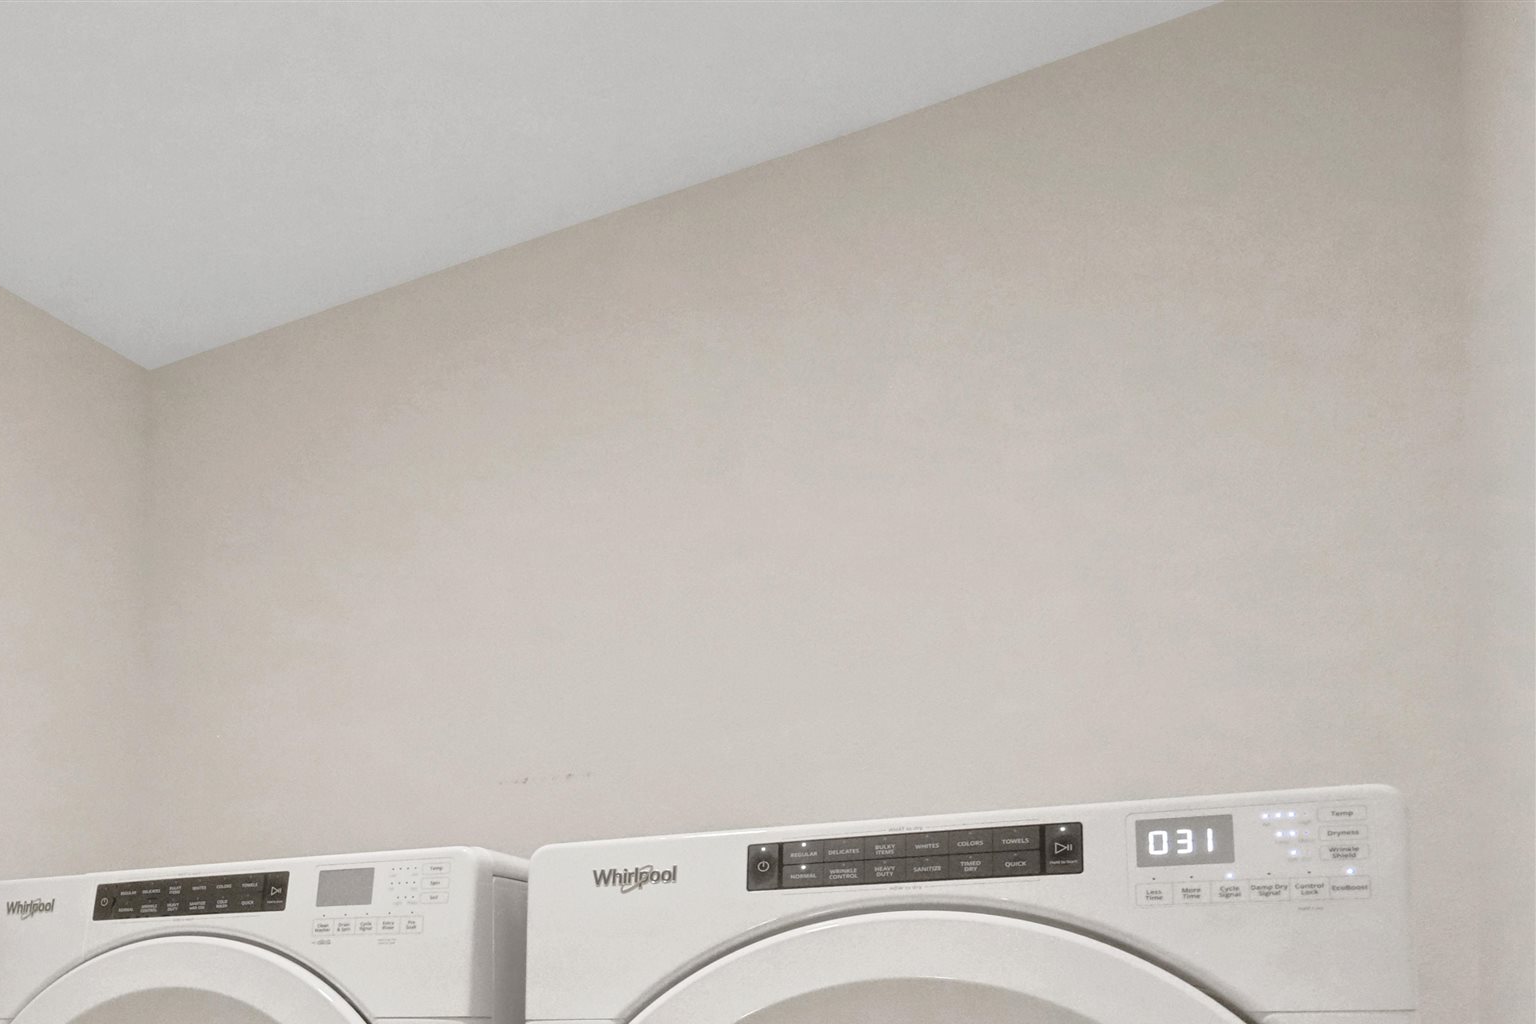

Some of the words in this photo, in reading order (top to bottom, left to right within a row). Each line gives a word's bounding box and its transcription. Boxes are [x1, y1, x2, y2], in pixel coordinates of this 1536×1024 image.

[1001, 837, 1030, 845] TOWELS
[1148, 828, 1214, 855] 031
[915, 842, 940, 850] WHITES
[828, 848, 860, 856] DELICATES
[913, 865, 942, 873] SANITIZE
[593, 864, 678, 894] Whirlpool
[1295, 882, 1325, 890] Control
[6, 898, 56, 920] Whirlpool
